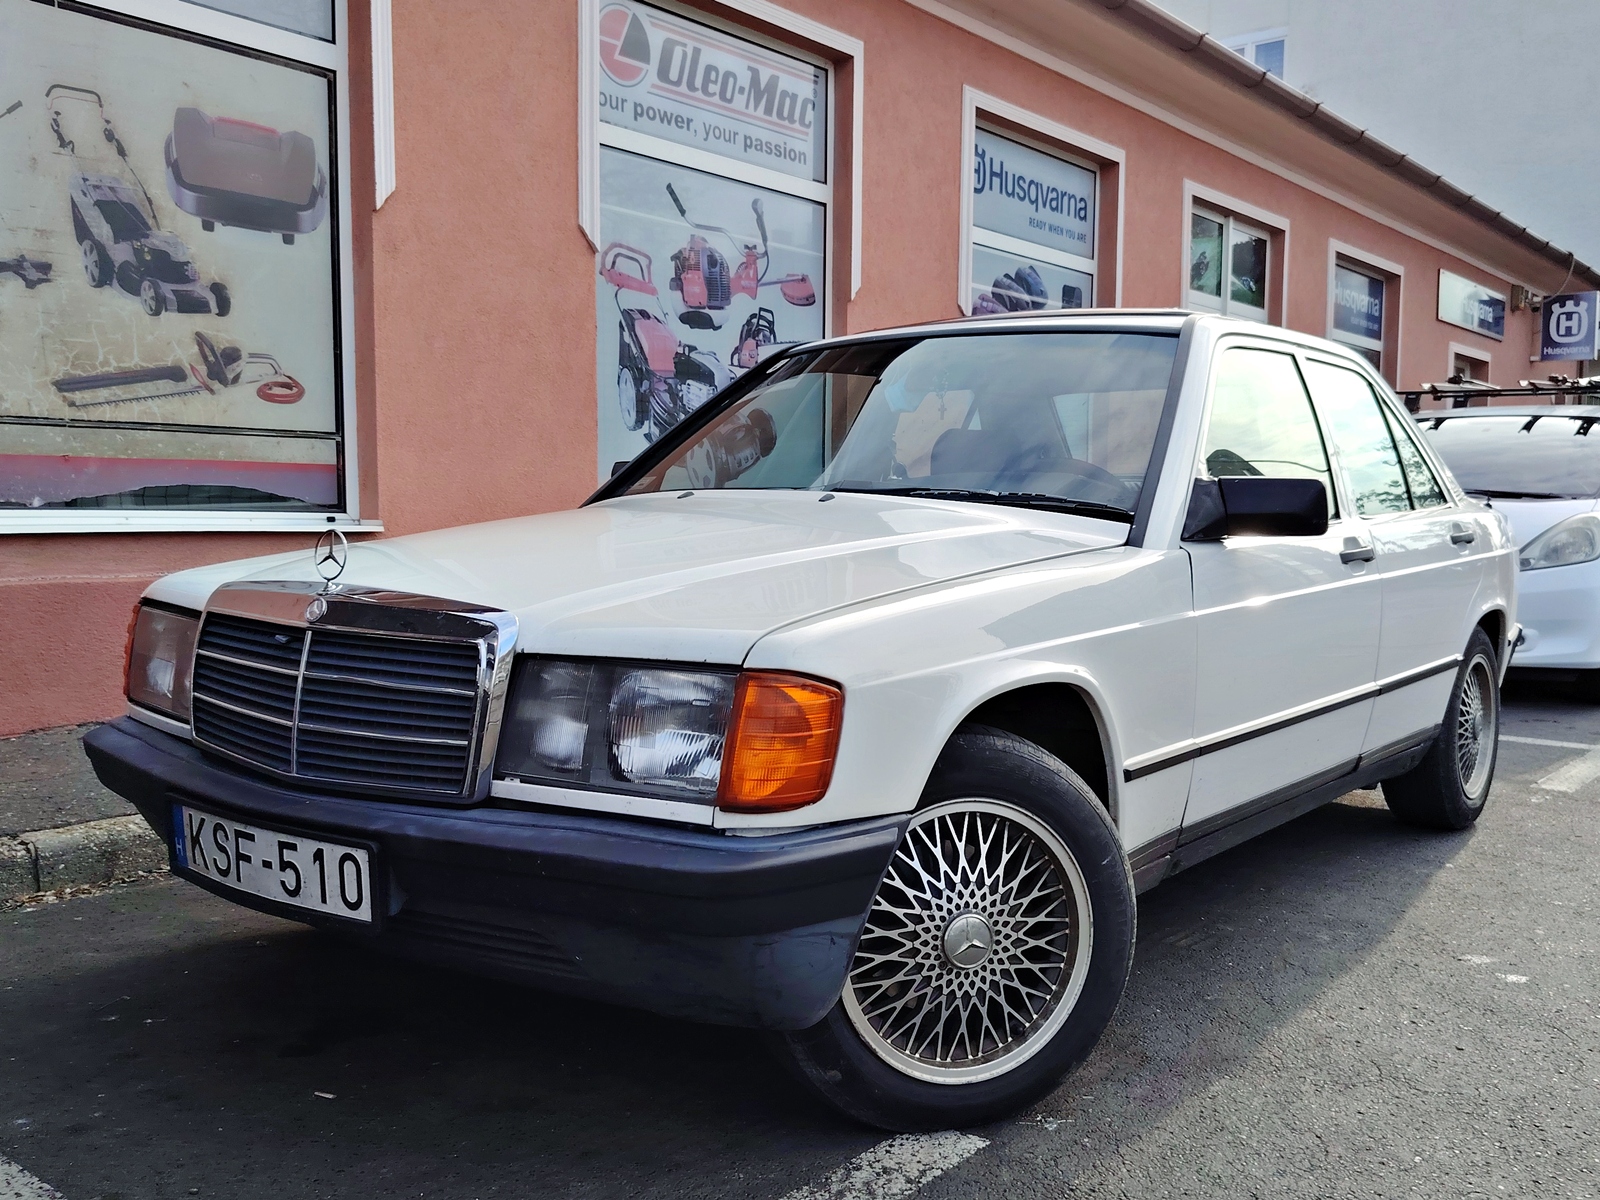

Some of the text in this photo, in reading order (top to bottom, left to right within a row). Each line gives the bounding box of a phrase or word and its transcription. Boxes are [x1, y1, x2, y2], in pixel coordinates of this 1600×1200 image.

[656, 36, 816, 130] Oleo-Mac
[633, 101, 698, 138] power,
[702, 120, 739, 145] your
[743, 133, 808, 166] passion
[988, 156, 1088, 223] Husqvarna
[1028, 216, 1087, 244] READY WHEN YOU ARE
[1543, 345, 1590, 356] Husqvarna
[175, 836, 185, 857] H
[187, 812, 364, 912] KSF-510
